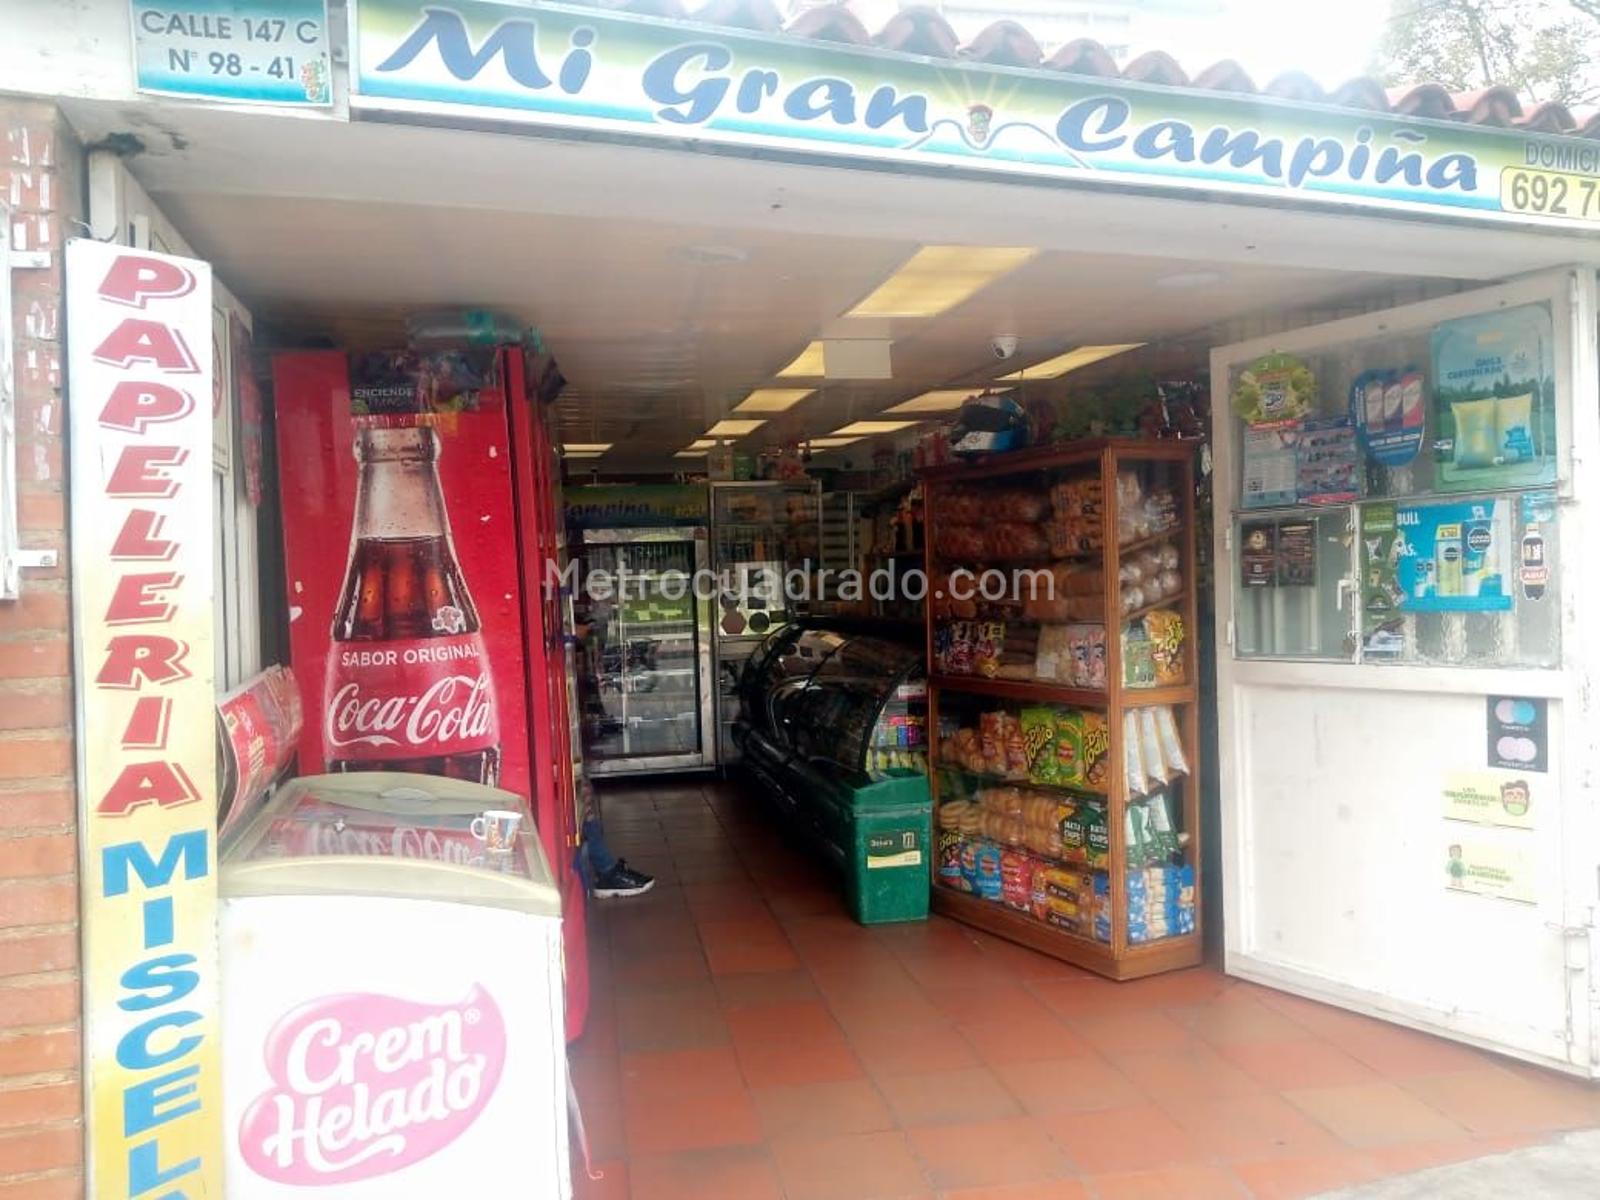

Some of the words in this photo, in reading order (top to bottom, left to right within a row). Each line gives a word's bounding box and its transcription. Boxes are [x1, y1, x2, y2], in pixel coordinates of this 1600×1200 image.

[141, 10, 231, 40] CALLE
[243, 18, 286, 43] 147
[296, 20, 318, 44] C
[208, 51, 242, 76] 98
[267, 57, 294, 80] 41
[375, 7, 598, 96] Mi
[642, 42, 929, 134] Gran
[1055, 96, 1478, 191] Campiña
[1511, 172, 1568, 214] 692
[1579, 179, 1600, 217] 7
[91, 254, 202, 819] PAPELERIA
[342, 650, 397, 667] SABOR
[403, 643, 481, 664] ORIGINAL
[327, 672, 493, 747] Coca-Cola
[100, 828, 209, 1200] MISCEL
[286, 1009, 464, 1096] Crem
[262, 1053, 487, 1173] Helado
